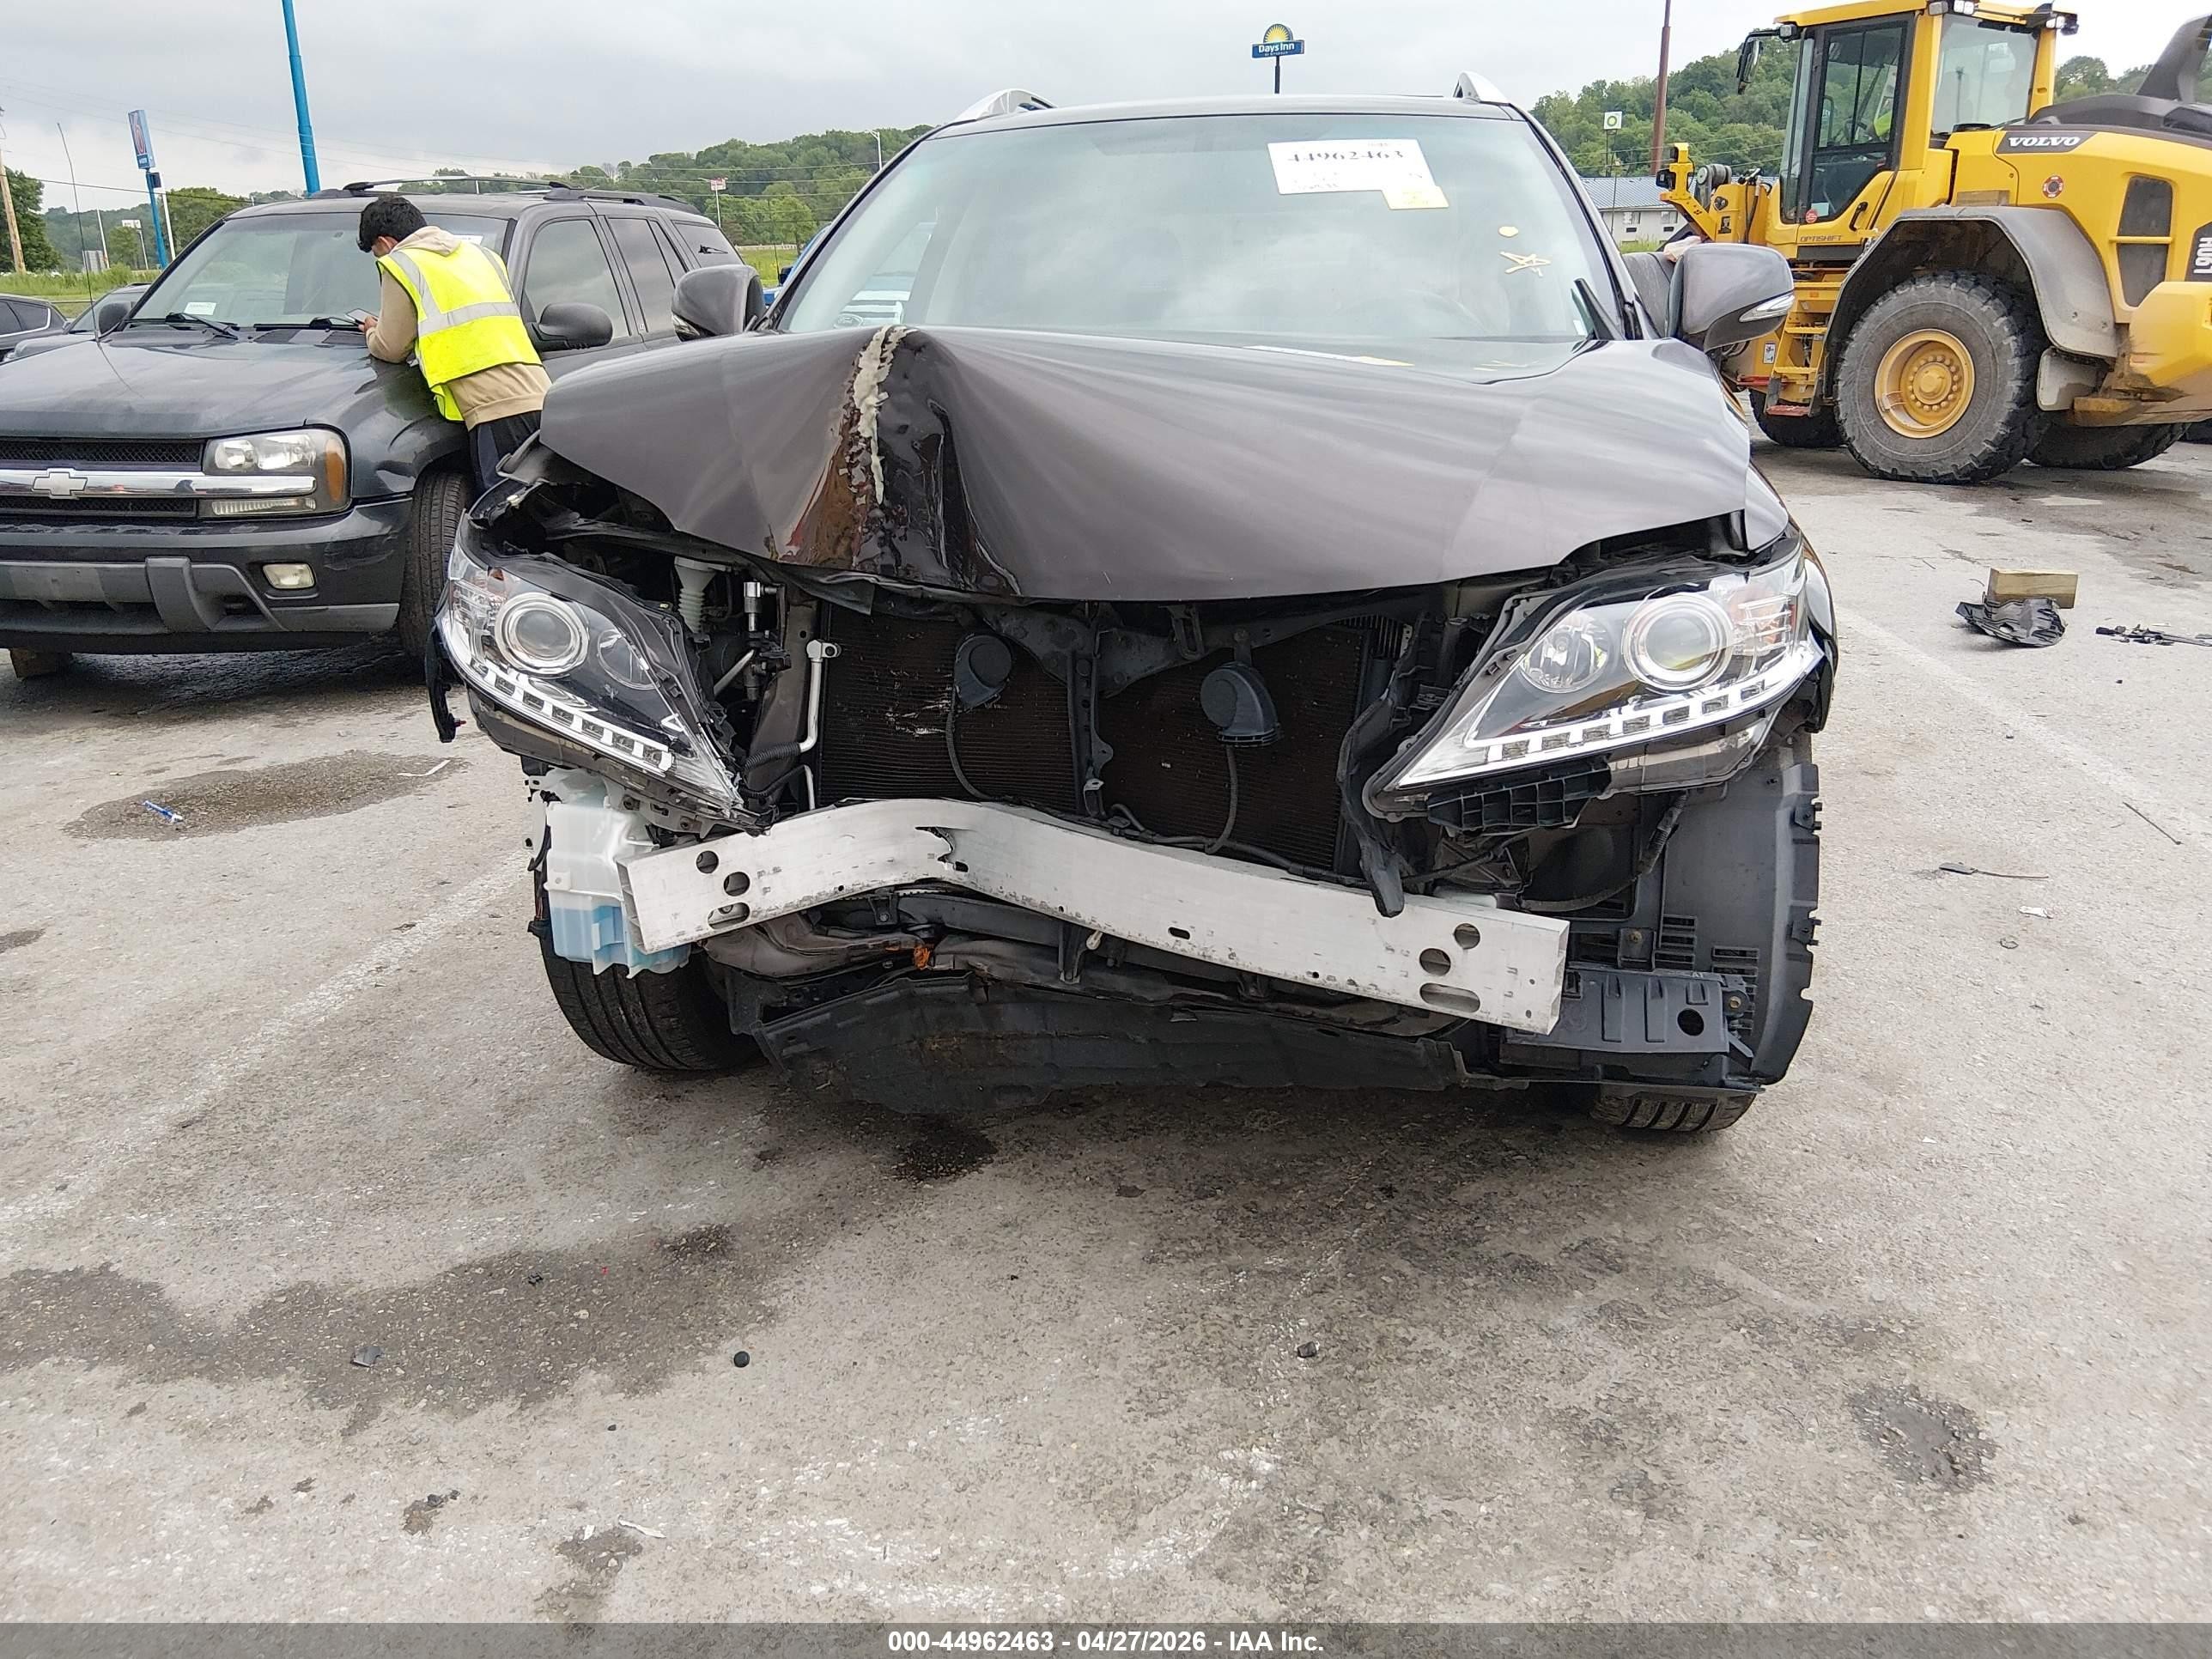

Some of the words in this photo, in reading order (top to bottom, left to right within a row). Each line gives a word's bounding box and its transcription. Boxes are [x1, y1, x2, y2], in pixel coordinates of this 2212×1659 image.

[1258, 44, 1280, 53] Days
[1280, 42, 1295, 51] Inn
[2008, 137, 2081, 147] VOLVO
